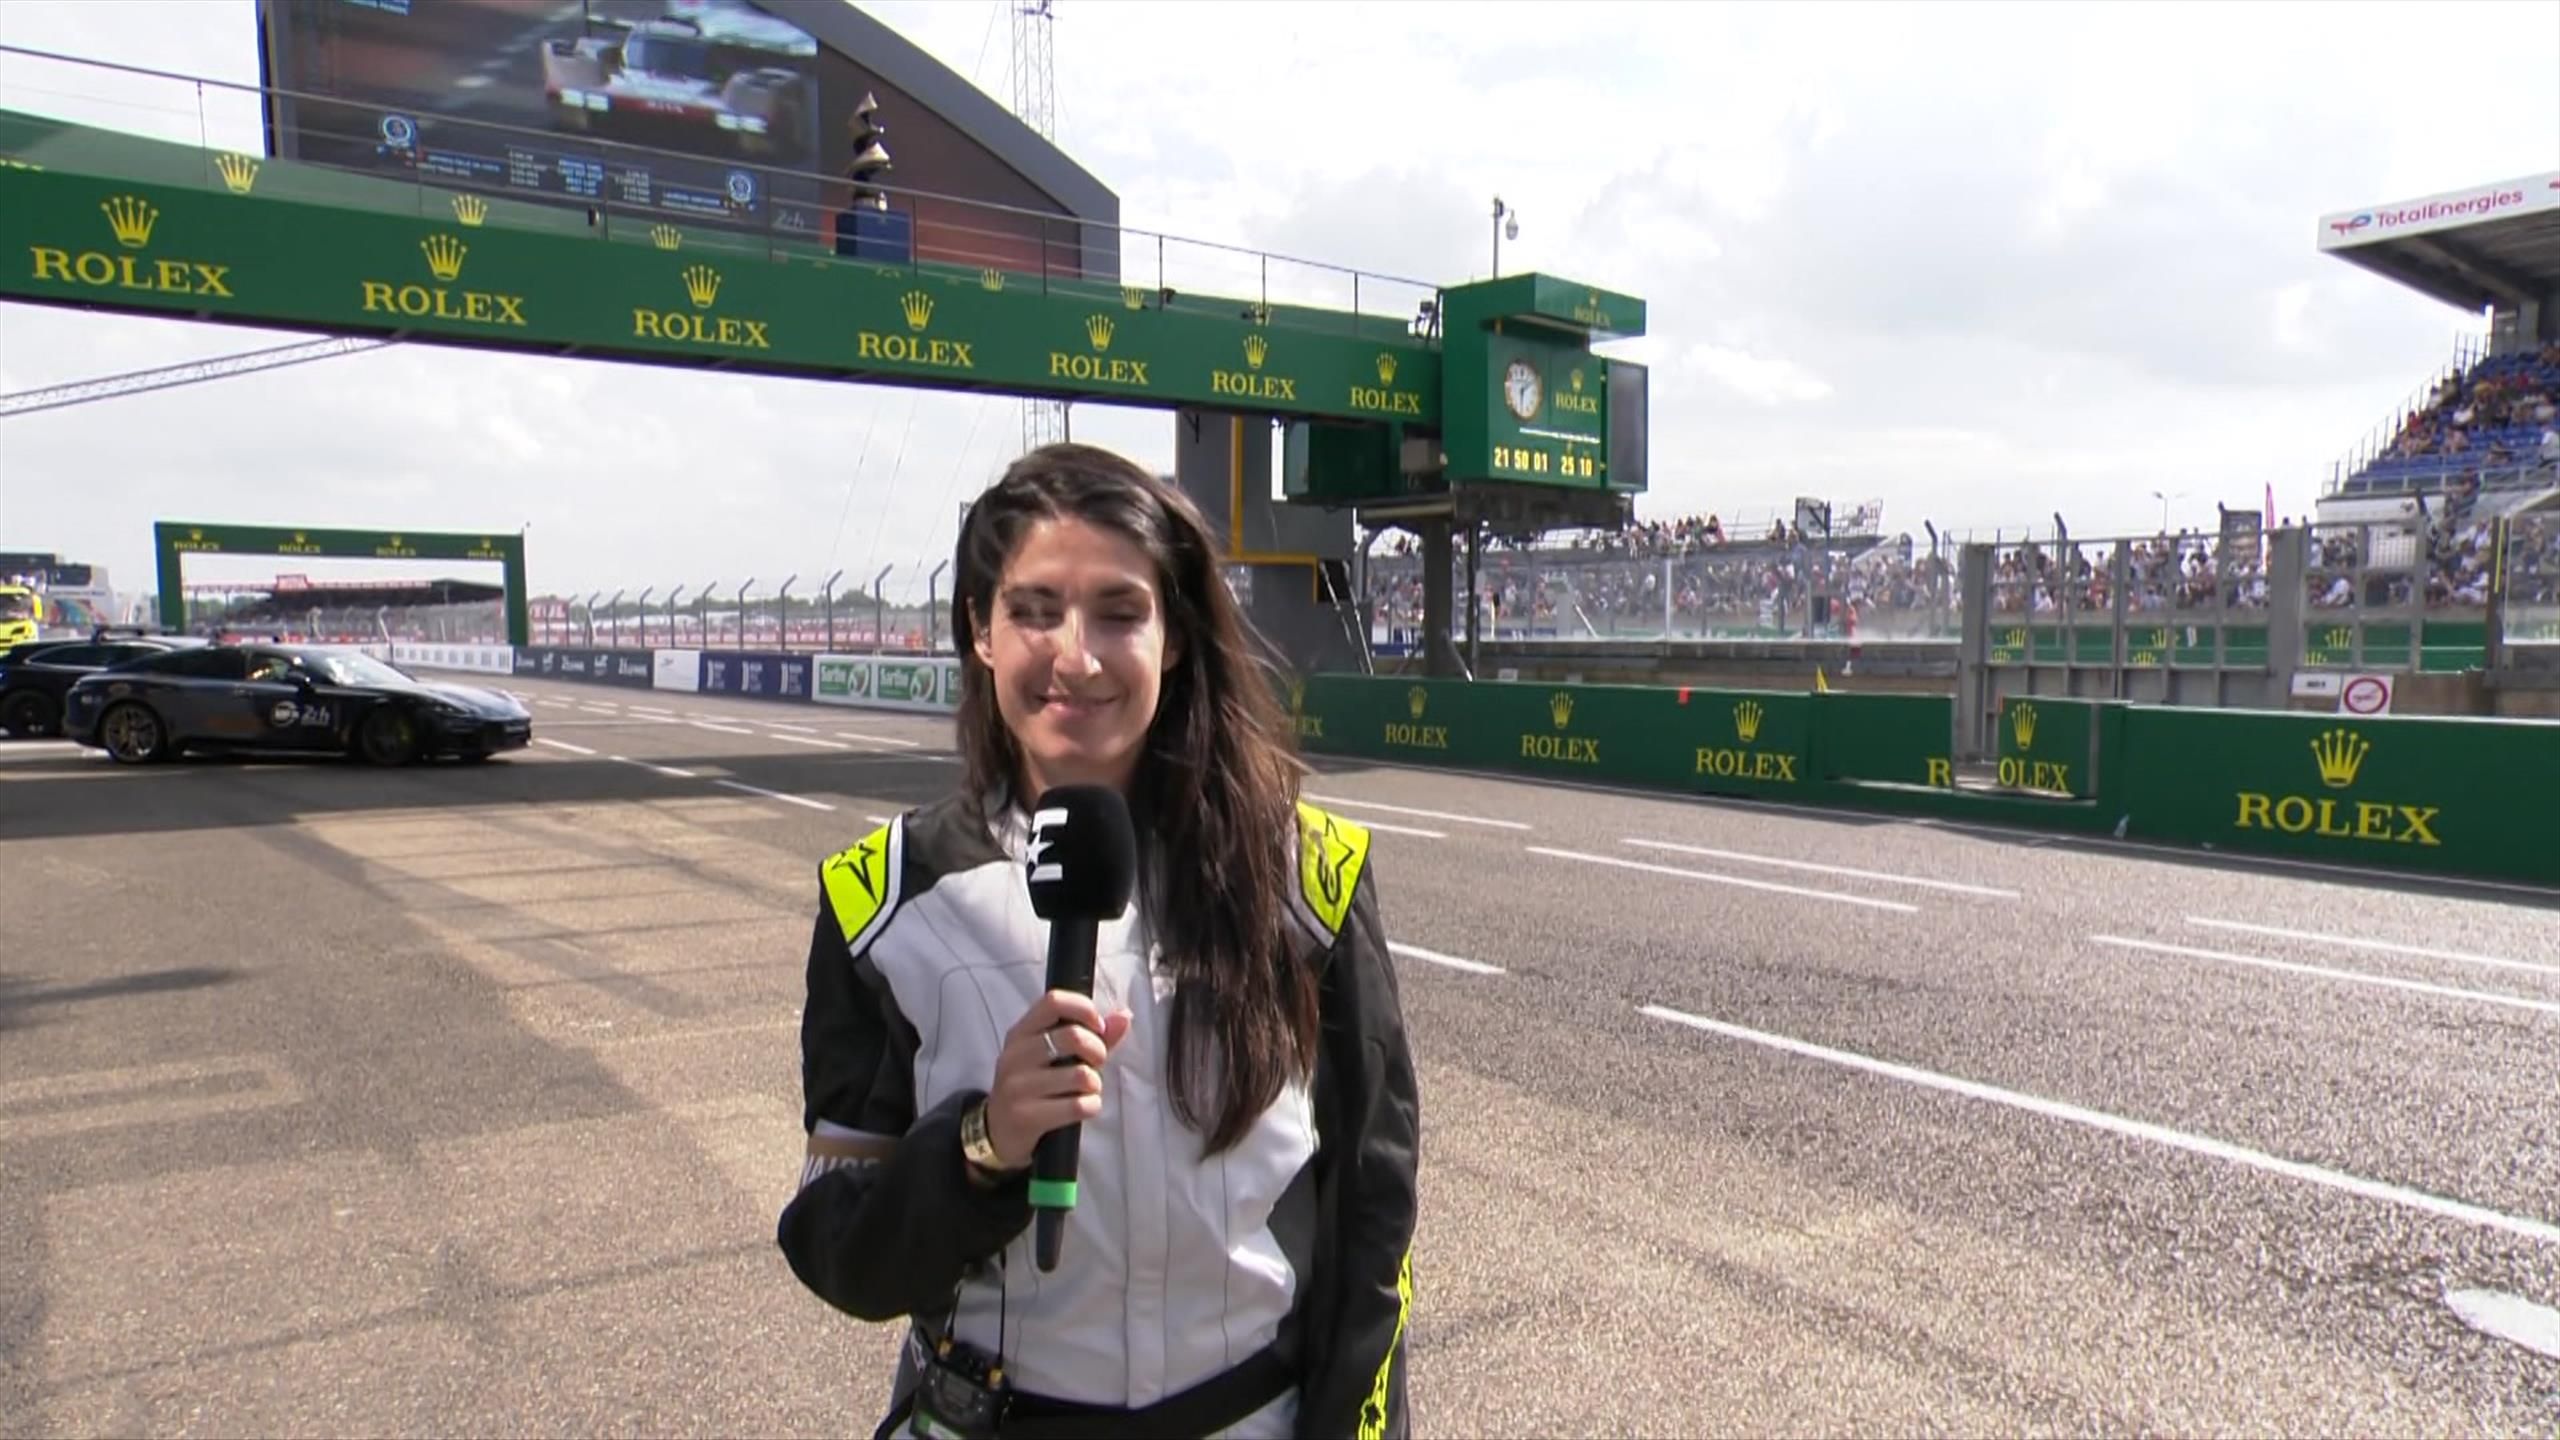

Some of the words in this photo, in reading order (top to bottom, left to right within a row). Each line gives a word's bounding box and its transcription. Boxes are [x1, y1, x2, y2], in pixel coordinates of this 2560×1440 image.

[2376, 190, 2523, 227] TotalEnergies
[31, 245, 234, 298] ROLEX
[362, 281, 528, 326] ROLEX
[1574, 306, 1611, 327] ROLEX
[633, 309, 770, 349] ROLEX
[858, 332, 974, 368] ROLEX
[1049, 352, 1149, 385] ROLEX
[1211, 370, 1296, 401] ROLEX
[1350, 386, 1420, 415] ROLEX
[1555, 392, 1597, 413] ROLEX
[1494, 446, 1509, 468] 21
[1514, 448, 1529, 471] 50
[1534, 451, 1548, 473] 01
[1580, 457, 1592, 477] 10
[1385, 723, 1448, 748] ROLEX
[1522, 734, 1600, 764] ROLEX
[1695, 748, 1798, 782] ROLEX
[2234, 793, 2442, 846] ROLEX
